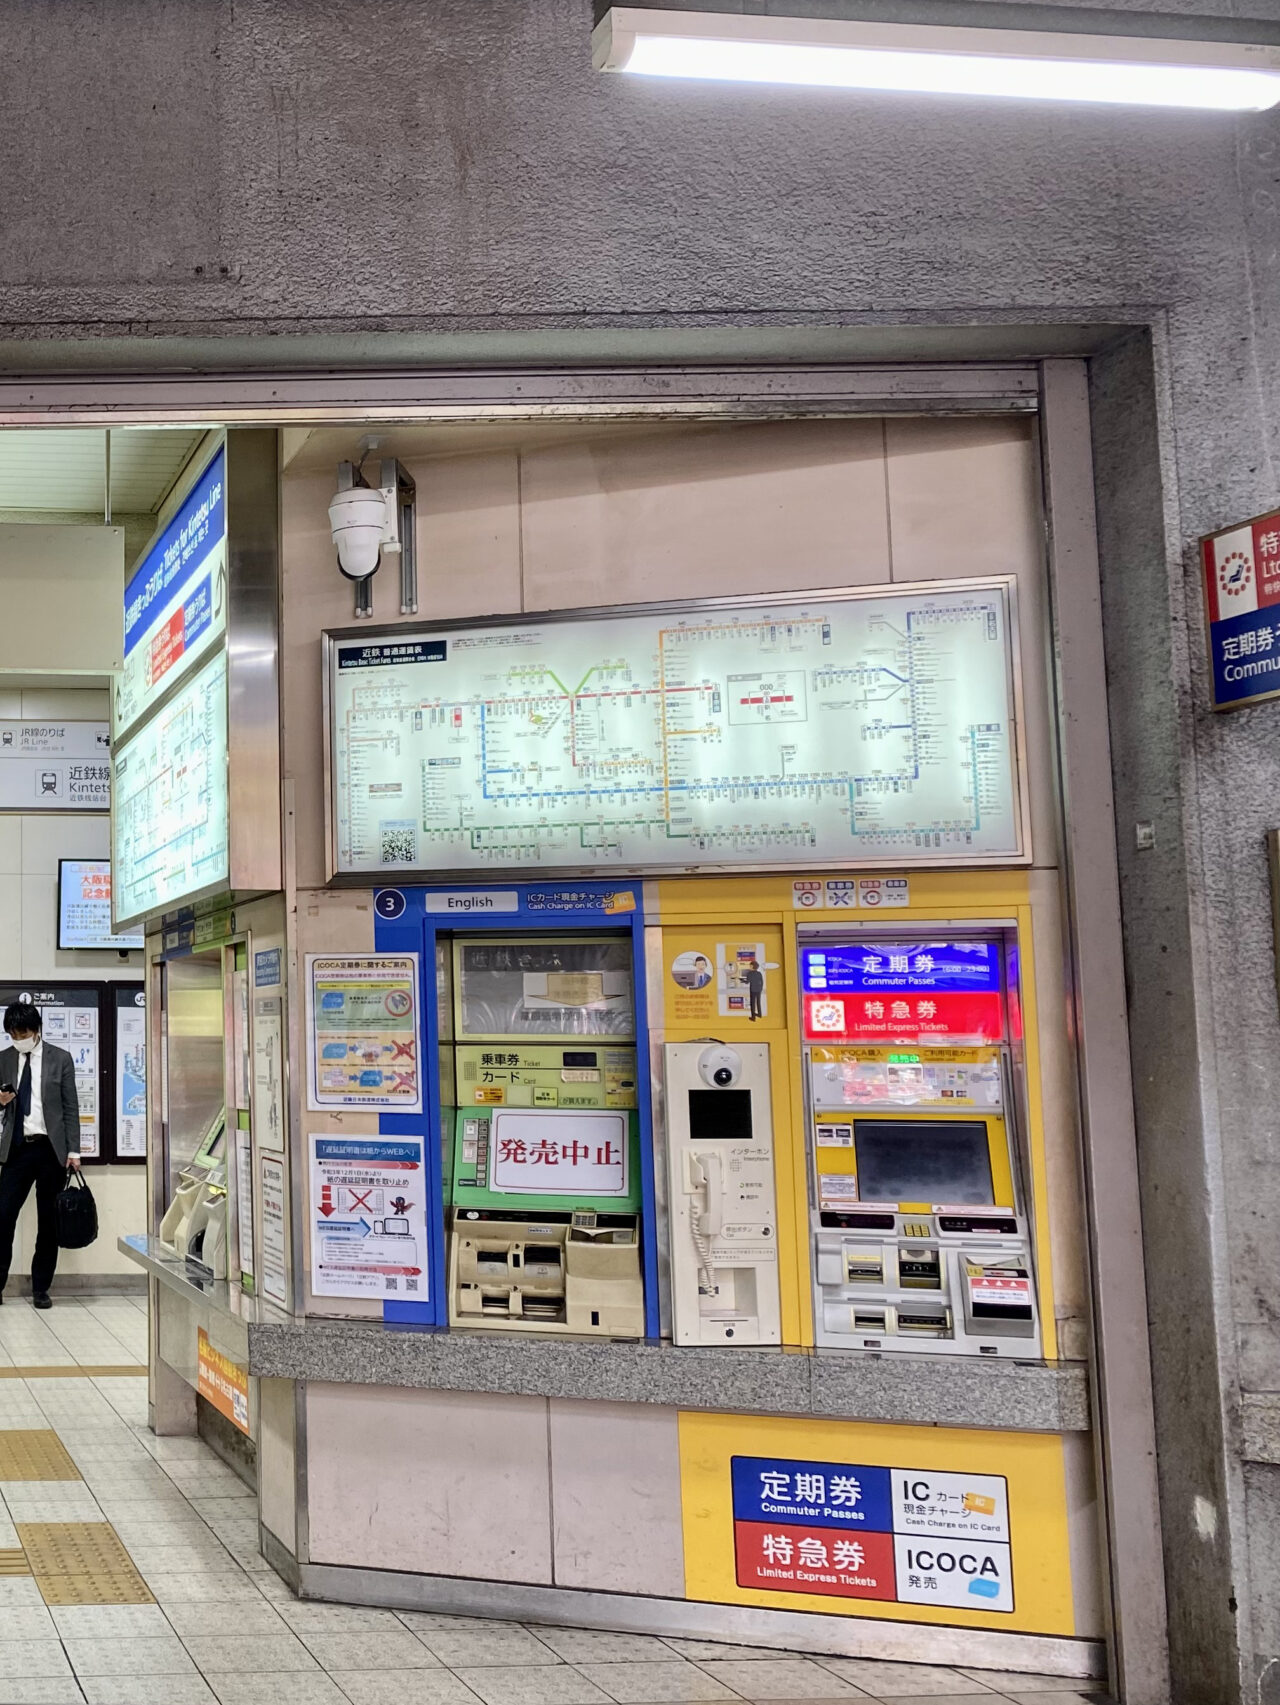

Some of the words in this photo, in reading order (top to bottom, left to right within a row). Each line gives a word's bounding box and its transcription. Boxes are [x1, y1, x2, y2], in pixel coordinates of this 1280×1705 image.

[209, 482, 221, 509] Line
[21, 728, 65, 737] JR線のりば
[448, 896, 493, 908] English
[527, 892, 614, 901] ICカード現金チャージ
[385, 898, 395, 910] 3
[528, 902, 545, 910] Cash
[547, 902, 573, 910] Charge
[317, 961, 408, 969] ICOCA定期券に関するご案内
[862, 954, 935, 974] 定期券
[862, 976, 907, 986] Commuter
[908, 977, 936, 986] Passes
[864, 1000, 937, 1019] 特急券
[855, 1023, 886, 1032] Limited
[887, 1023, 919, 1033] Express
[920, 1023, 948, 1032] Tickets
[481, 1053, 520, 1066] 乗車券
[482, 1071, 520, 1083] カード
[498, 1139, 621, 1166] 発売中止
[326, 1176, 410, 1185] 紙の遅延証明書を取り止め
[760, 1471, 862, 1506] 定期券
[903, 1480, 930, 1501] IC
[937, 1491, 969, 1504] カード
[761, 1503, 821, 1517] Commuter
[824, 1508, 865, 1520] Passes
[903, 1503, 971, 1518] 現金チャージ
[906, 1518, 926, 1526] Cash
[928, 1519, 957, 1529] Charge
[981, 1524, 1000, 1532] Card
[762, 1534, 865, 1572] 特急券
[908, 1549, 1000, 1577] ICOCA
[757, 1567, 794, 1580] Limited
[796, 1571, 837, 1584] Express
[840, 1574, 877, 1587] Tickets
[908, 1575, 937, 1590] 発売
